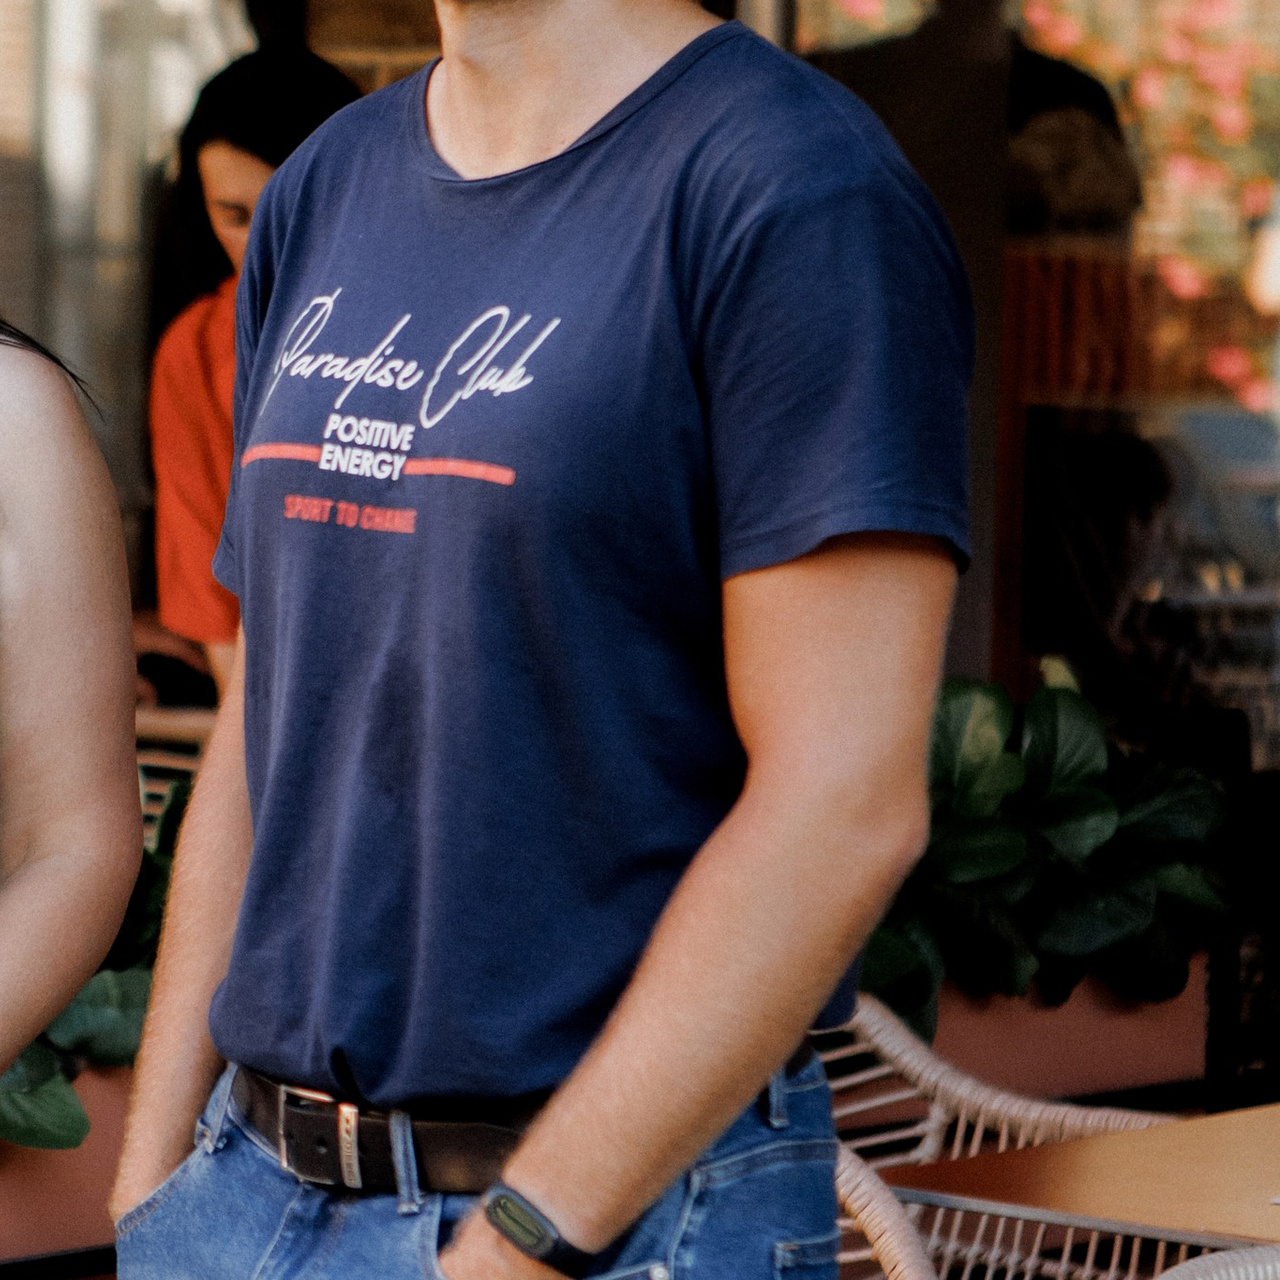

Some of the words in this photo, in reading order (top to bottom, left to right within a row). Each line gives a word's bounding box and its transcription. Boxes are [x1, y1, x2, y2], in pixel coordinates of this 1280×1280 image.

[258, 287, 425, 419] Paradise
[419, 305, 562, 430] Club
[323, 412, 416, 452] POSITIVE
[318, 442, 408, 481] ENERGY
[336, 501, 360, 528] TO
